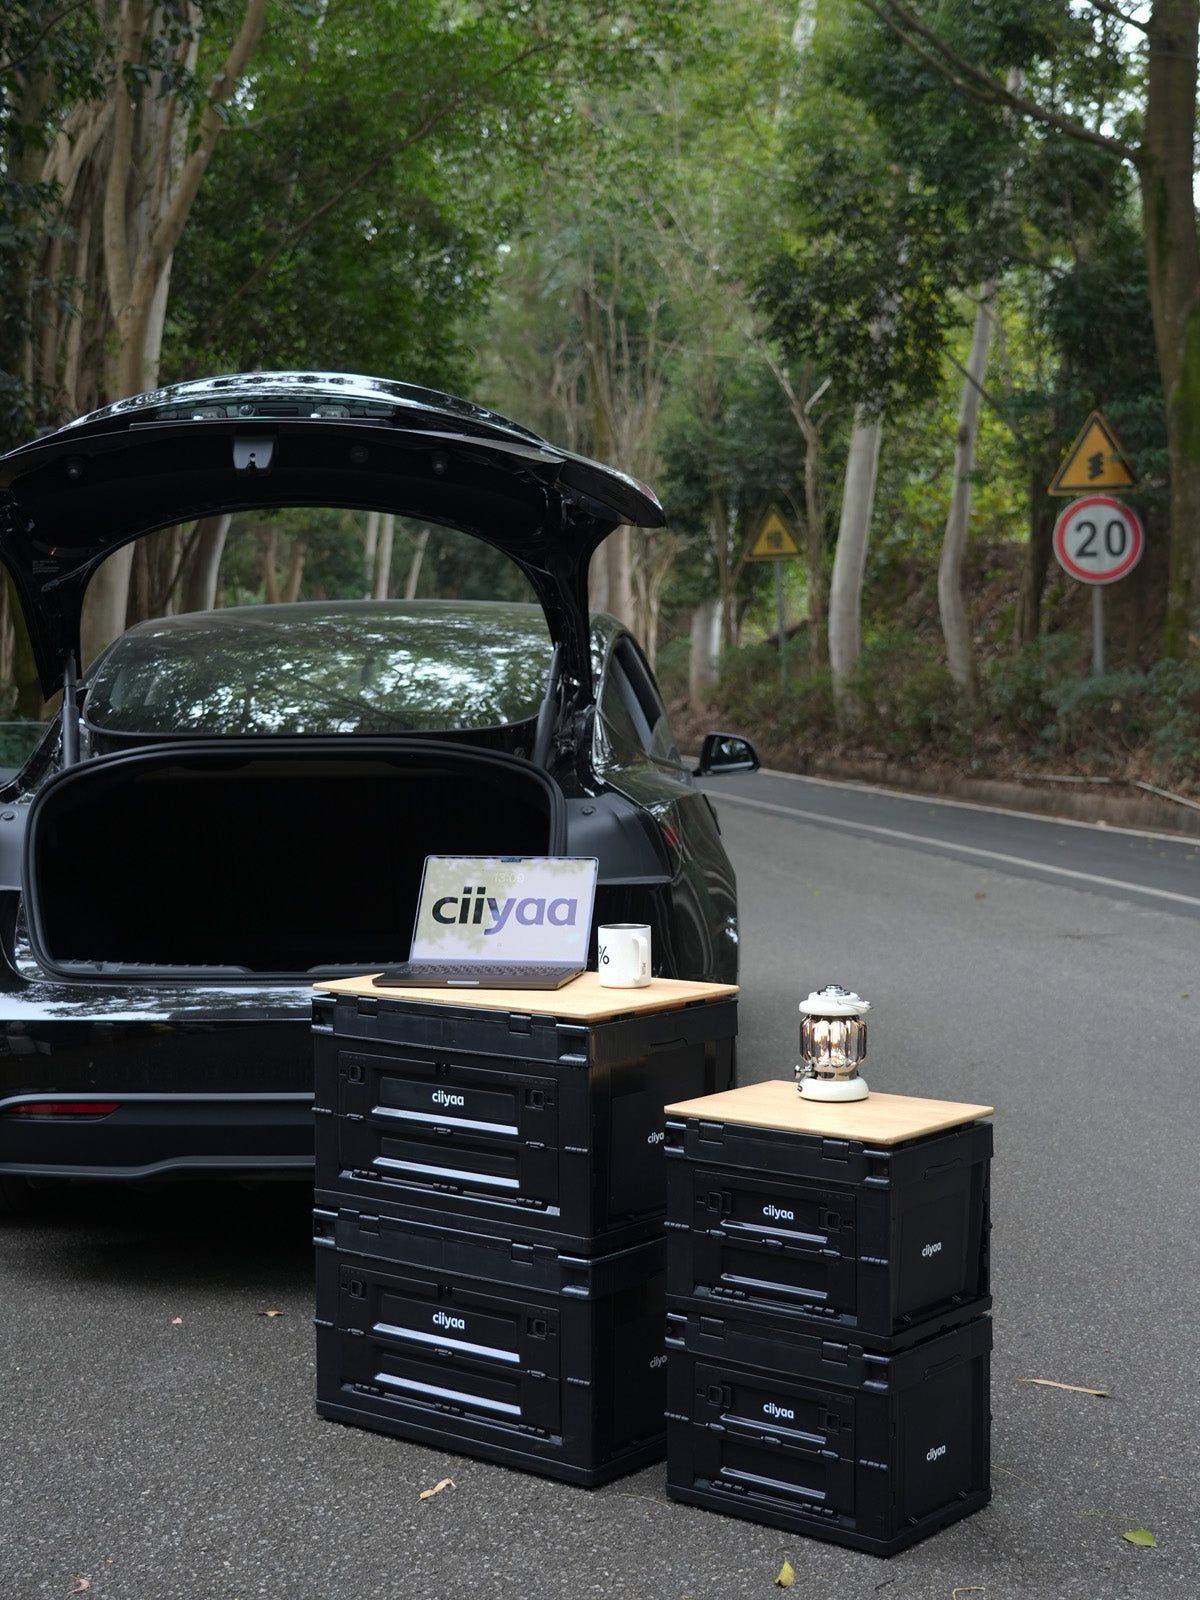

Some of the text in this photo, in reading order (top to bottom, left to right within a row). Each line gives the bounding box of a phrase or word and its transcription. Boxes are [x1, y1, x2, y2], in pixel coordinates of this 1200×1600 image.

[1074, 520, 1127, 558] 20
[431, 886, 578, 935] ciiyaa
[431, 1089, 465, 1107] ciiyaa
[647, 1131, 665, 1144] ciiya
[762, 1204, 795, 1221] ciiyaa
[921, 1241, 942, 1257] ciiyaa
[431, 1311, 466, 1330] ciiyaa
[762, 1402, 795, 1420] ciiyaa
[926, 1444, 947, 1461] ciiyaa
